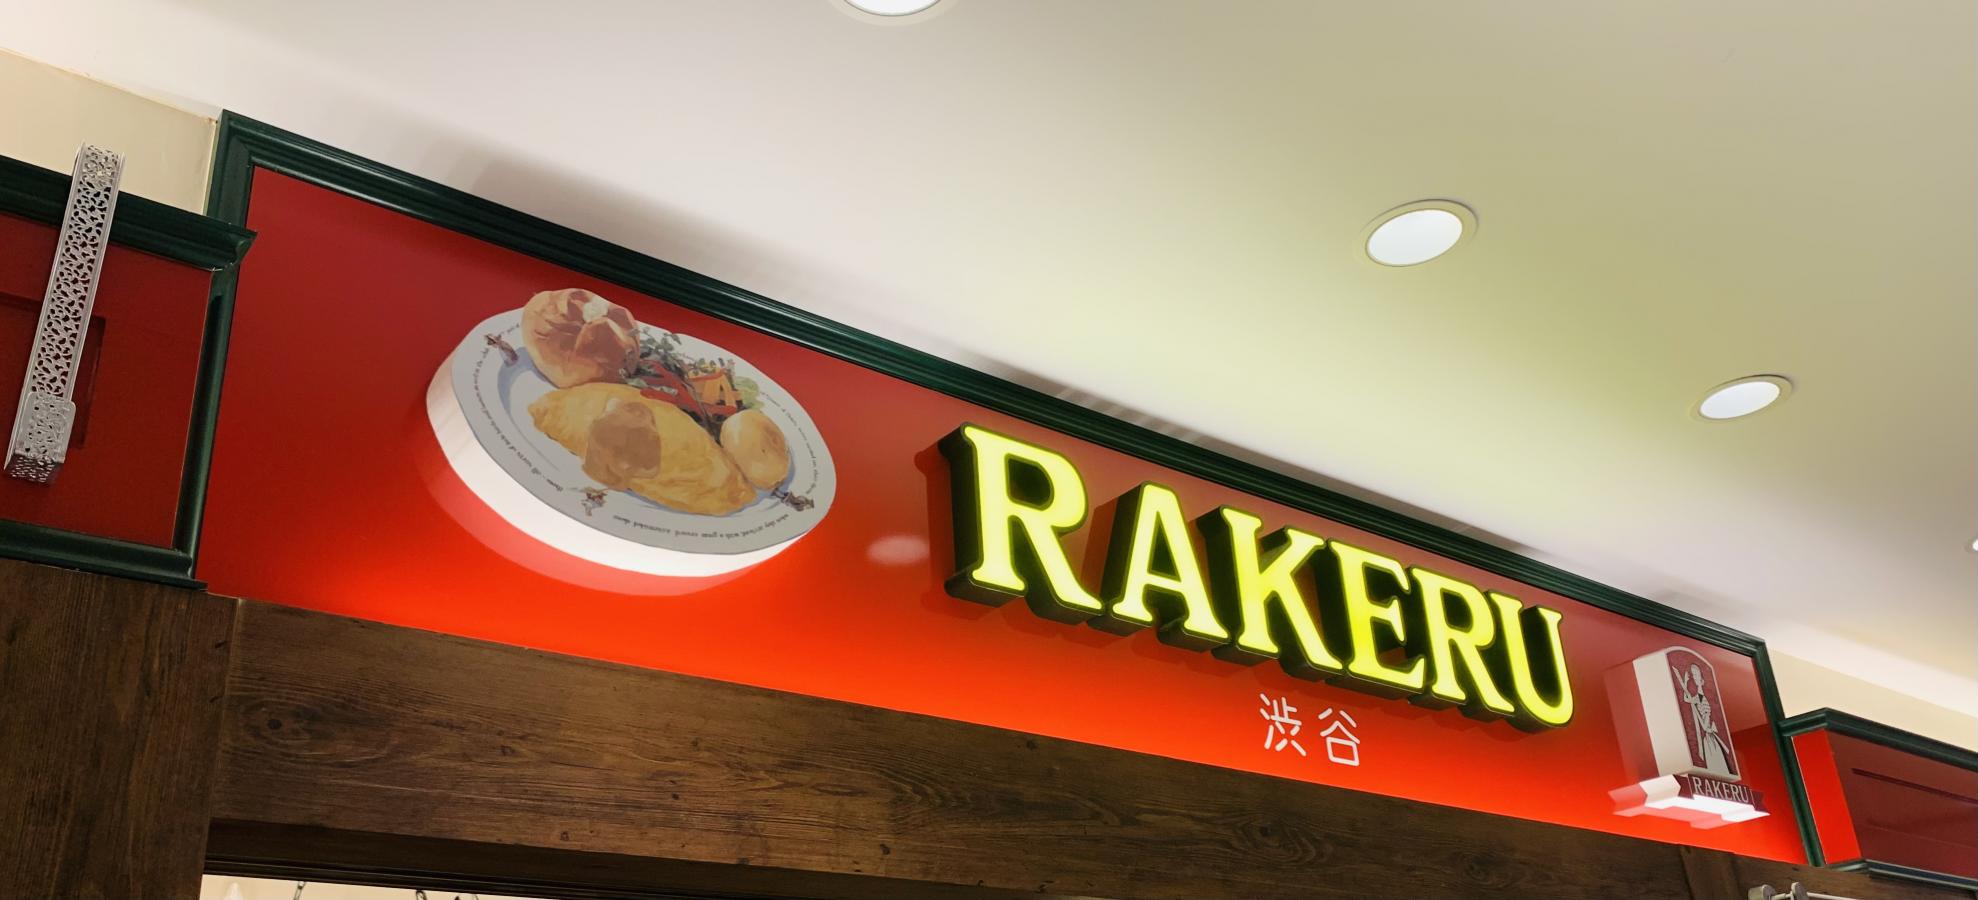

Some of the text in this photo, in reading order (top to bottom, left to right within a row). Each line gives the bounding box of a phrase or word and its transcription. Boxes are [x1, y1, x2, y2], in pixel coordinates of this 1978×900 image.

[961, 424, 1573, 727] RAKERU
[1260, 693, 1360, 766] 渋谷
[1692, 775, 1750, 804] RAKERU
